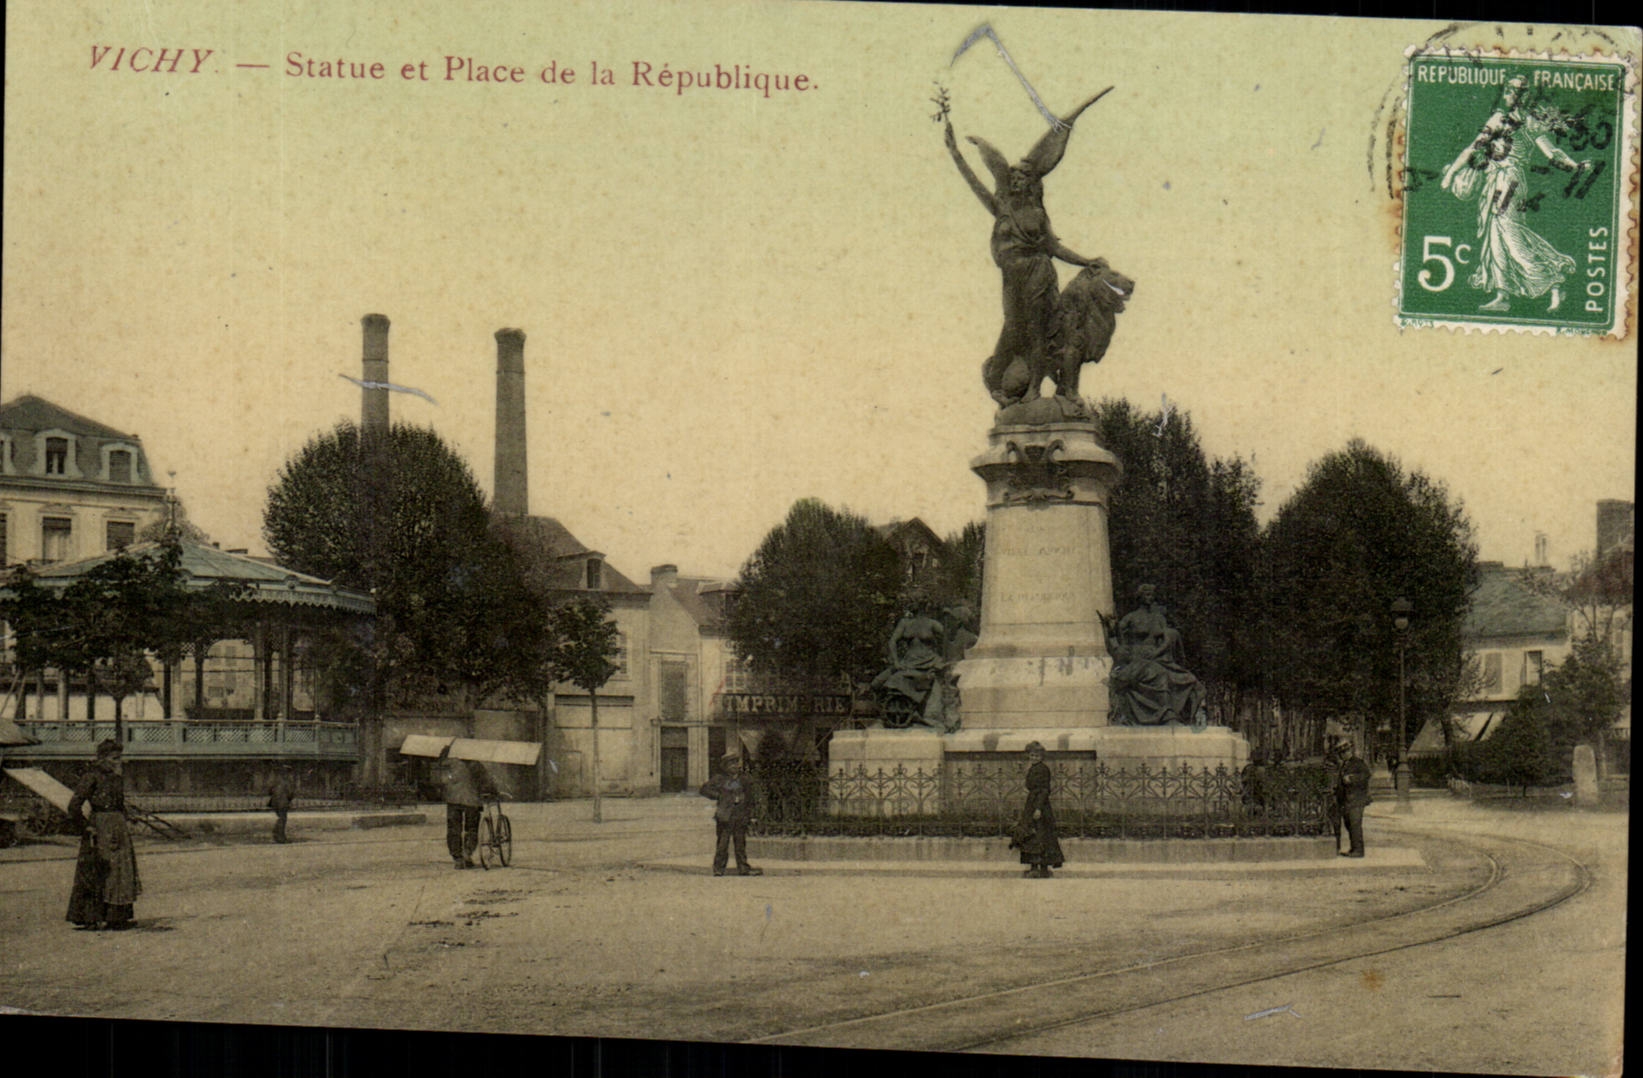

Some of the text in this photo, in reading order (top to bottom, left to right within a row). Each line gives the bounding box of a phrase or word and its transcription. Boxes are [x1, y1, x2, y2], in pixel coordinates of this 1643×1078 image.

[1533, 70, 1615, 91] FRANÇAISE
[1585, 226, 1609, 312] POSTES
[726, 694, 846, 713] IMPRIMRIE
